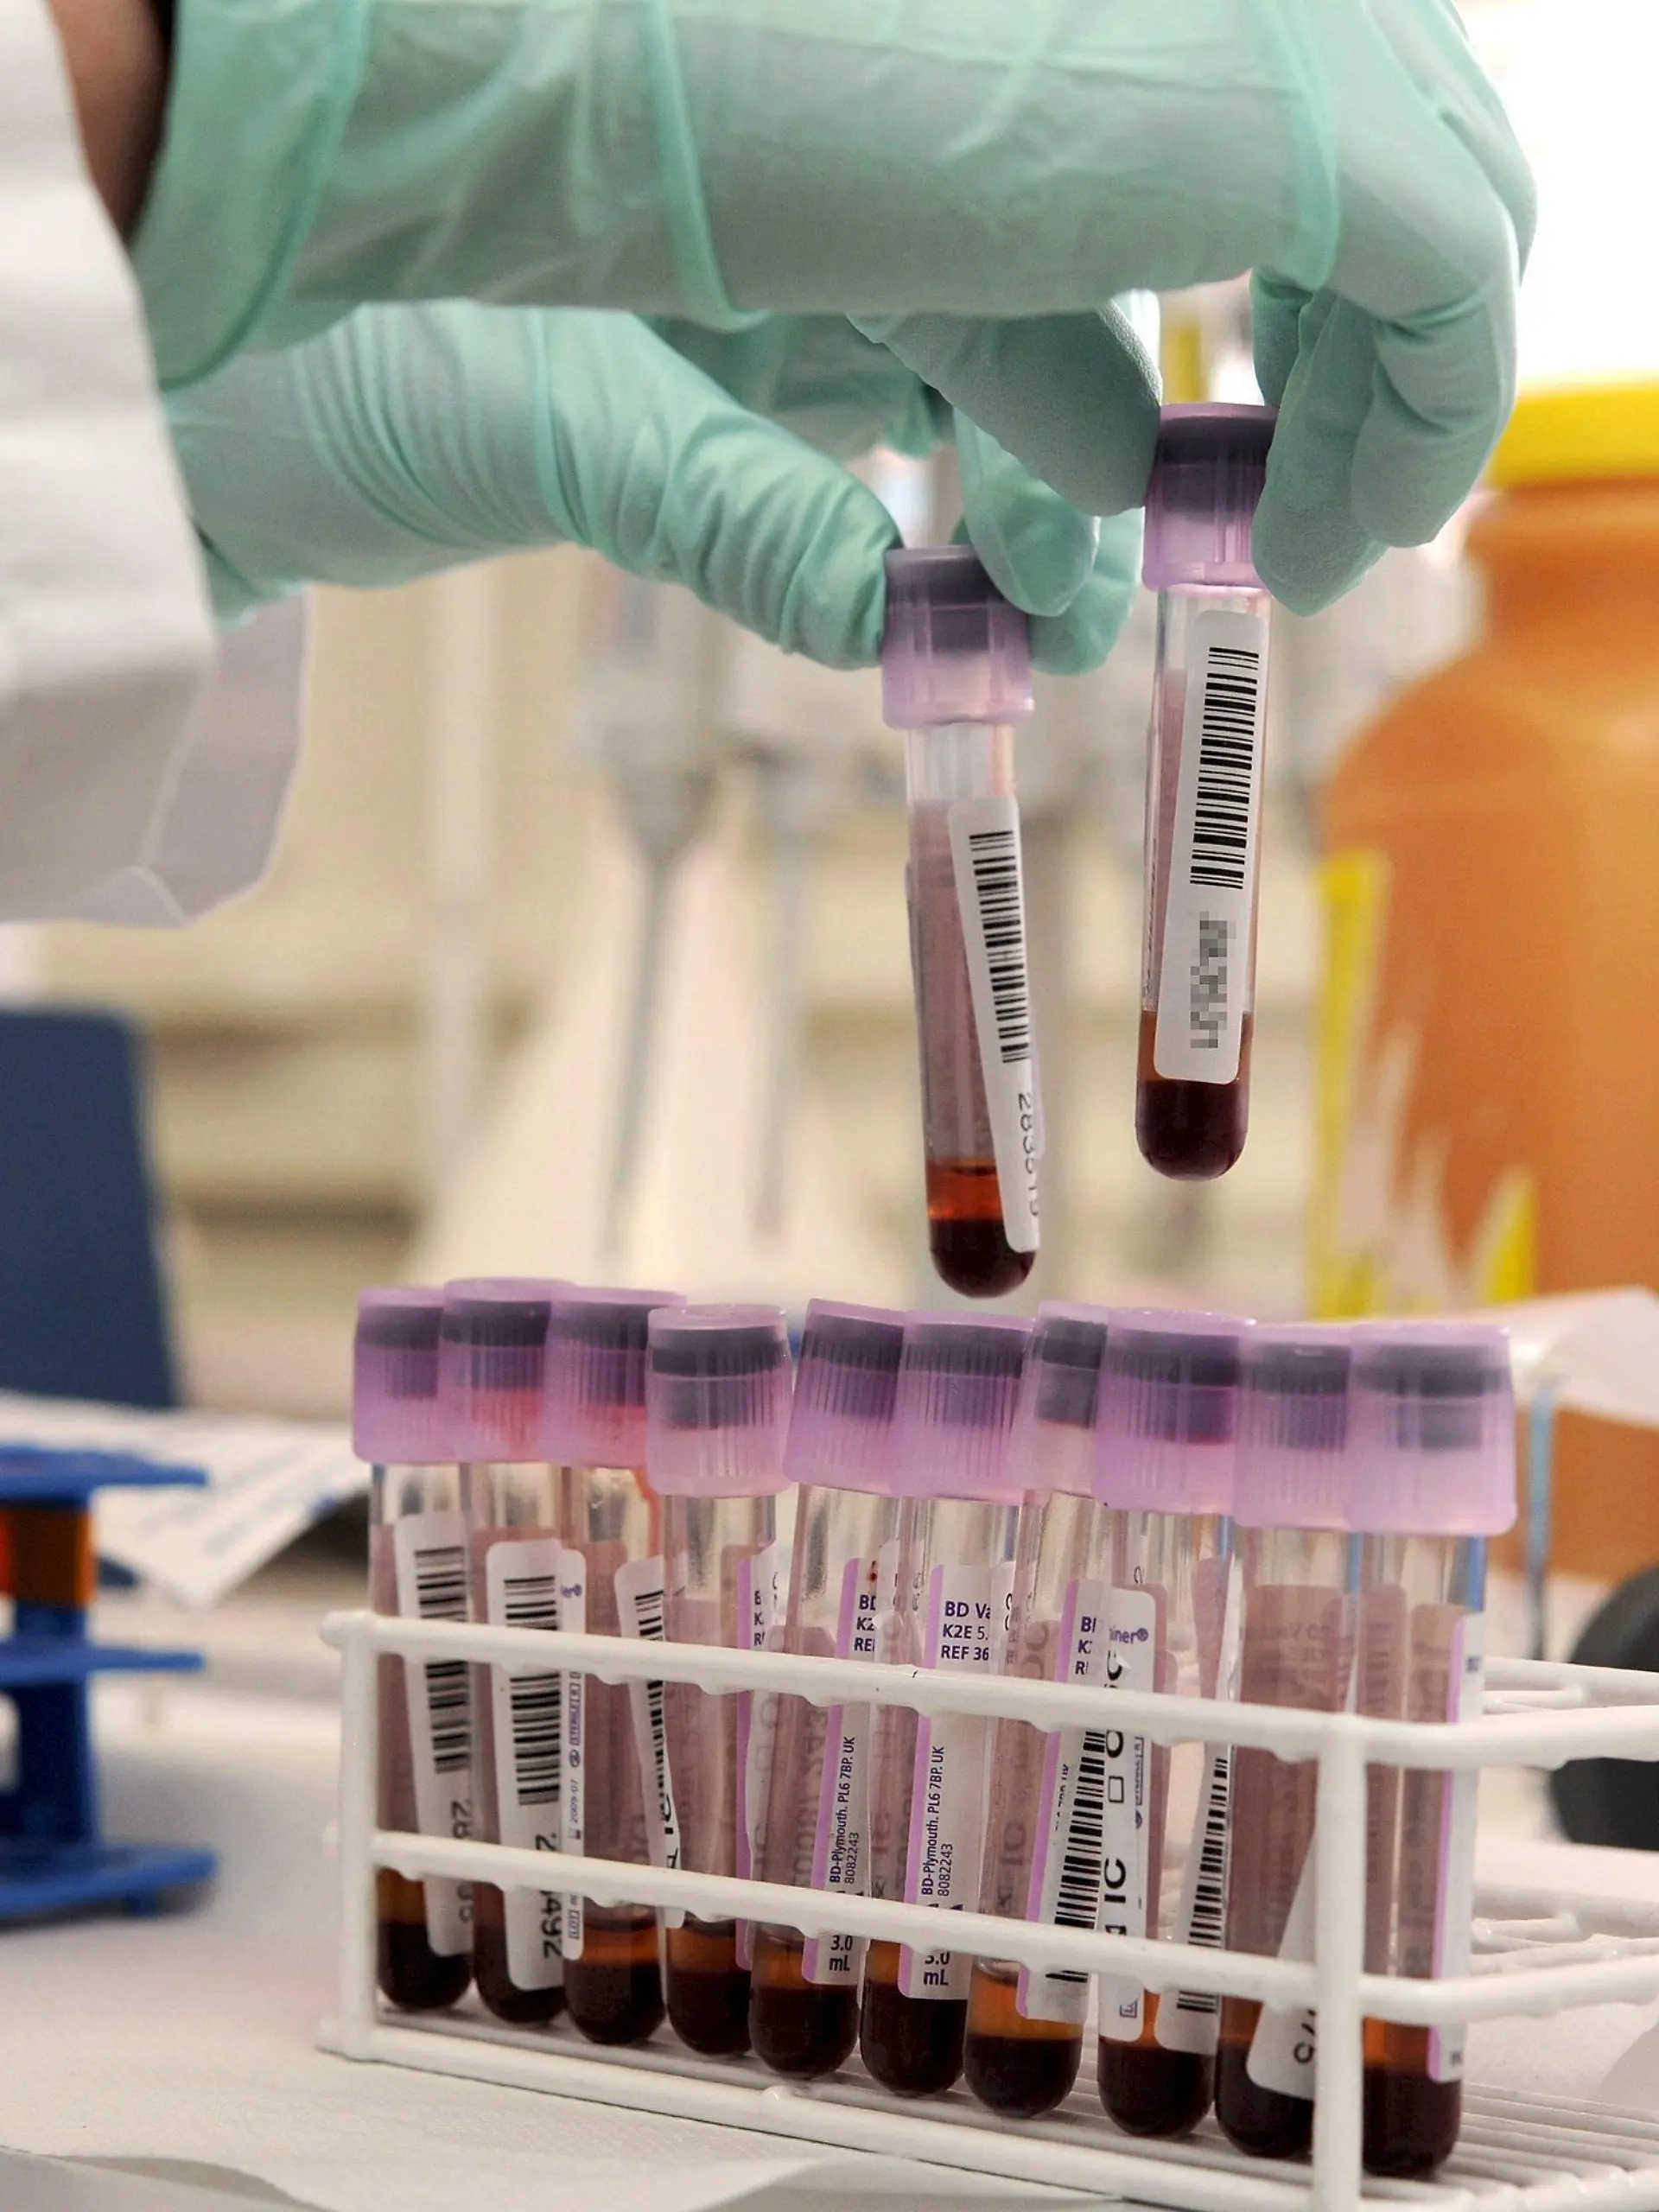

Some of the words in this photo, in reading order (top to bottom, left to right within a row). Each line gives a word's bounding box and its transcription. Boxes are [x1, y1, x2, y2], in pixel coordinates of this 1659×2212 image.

[944, 1600, 969, 1618] BD
[943, 1624, 973, 1639] K2E
[940, 1644, 969, 1660] REF
[973, 1646, 989, 1661] 36
[843, 1737, 855, 1753] UK
[931, 1745, 944, 1763] UK
[837, 1783, 851, 1803] PL6
[927, 1793, 941, 1814] PL6
[844, 1832, 860, 1885] 8082243
[938, 1843, 953, 1897] 8082243
[830, 1935, 853, 1951] 3.0
[829, 1955, 851, 1972] mL
[923, 1969, 950, 1986] mL
